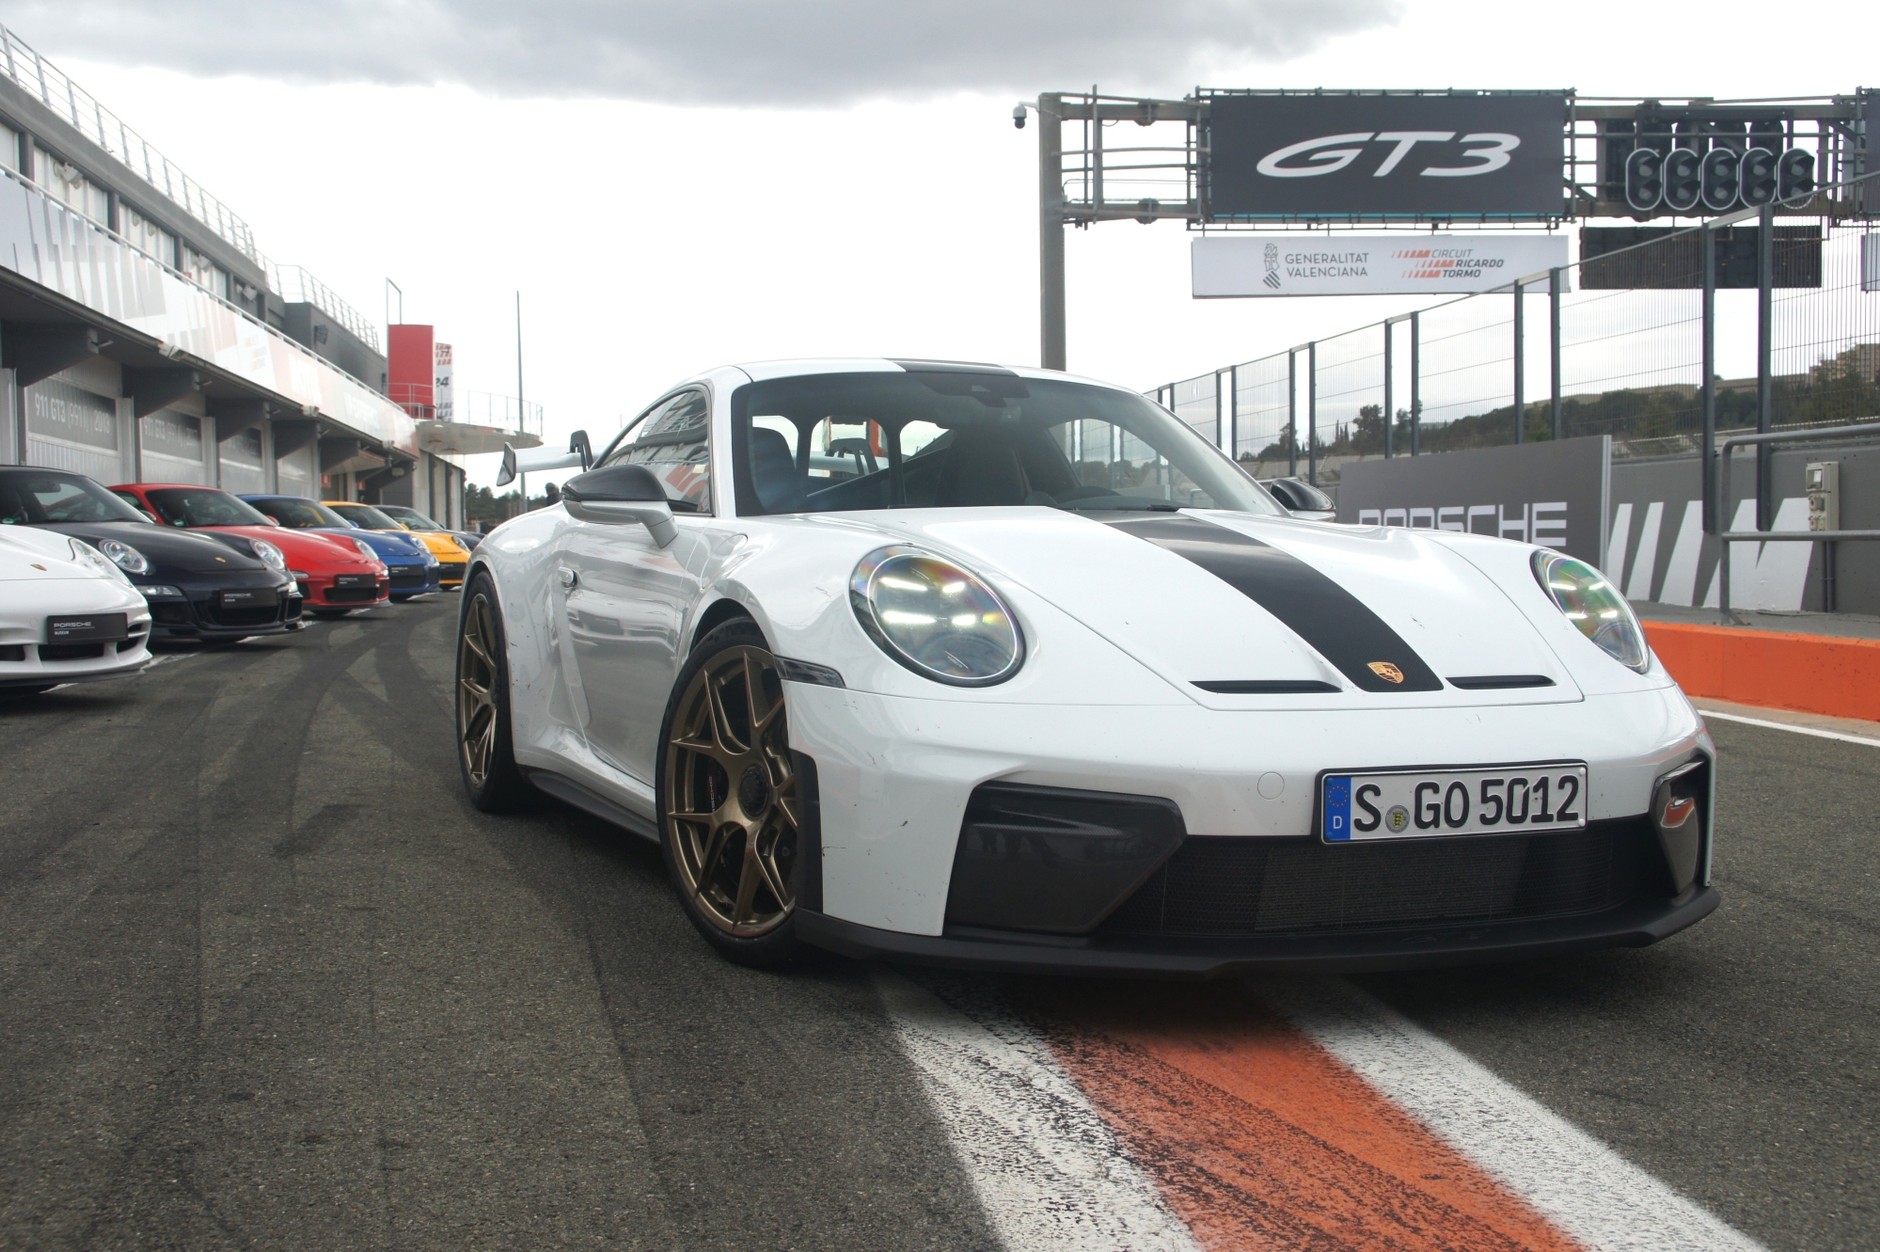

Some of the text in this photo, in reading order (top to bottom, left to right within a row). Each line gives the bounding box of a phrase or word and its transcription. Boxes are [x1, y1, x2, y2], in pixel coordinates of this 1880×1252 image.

[1256, 131, 1521, 178] GT3
[1285, 252, 1370, 264] GENERALITAT
[1431, 249, 1473, 258] CIRCUIT
[1455, 258, 1504, 268] RICARDO
[1286, 267, 1368, 278] VALENCIANA
[1442, 269, 1481, 279] TORMO
[35, 392, 49, 419] 911
[51, 398, 66, 423] GT3
[1354, 783, 1382, 832] S
[1414, 781, 1470, 830] GO
[1479, 775, 1579, 826] 5012
[1333, 815, 1343, 829] D
